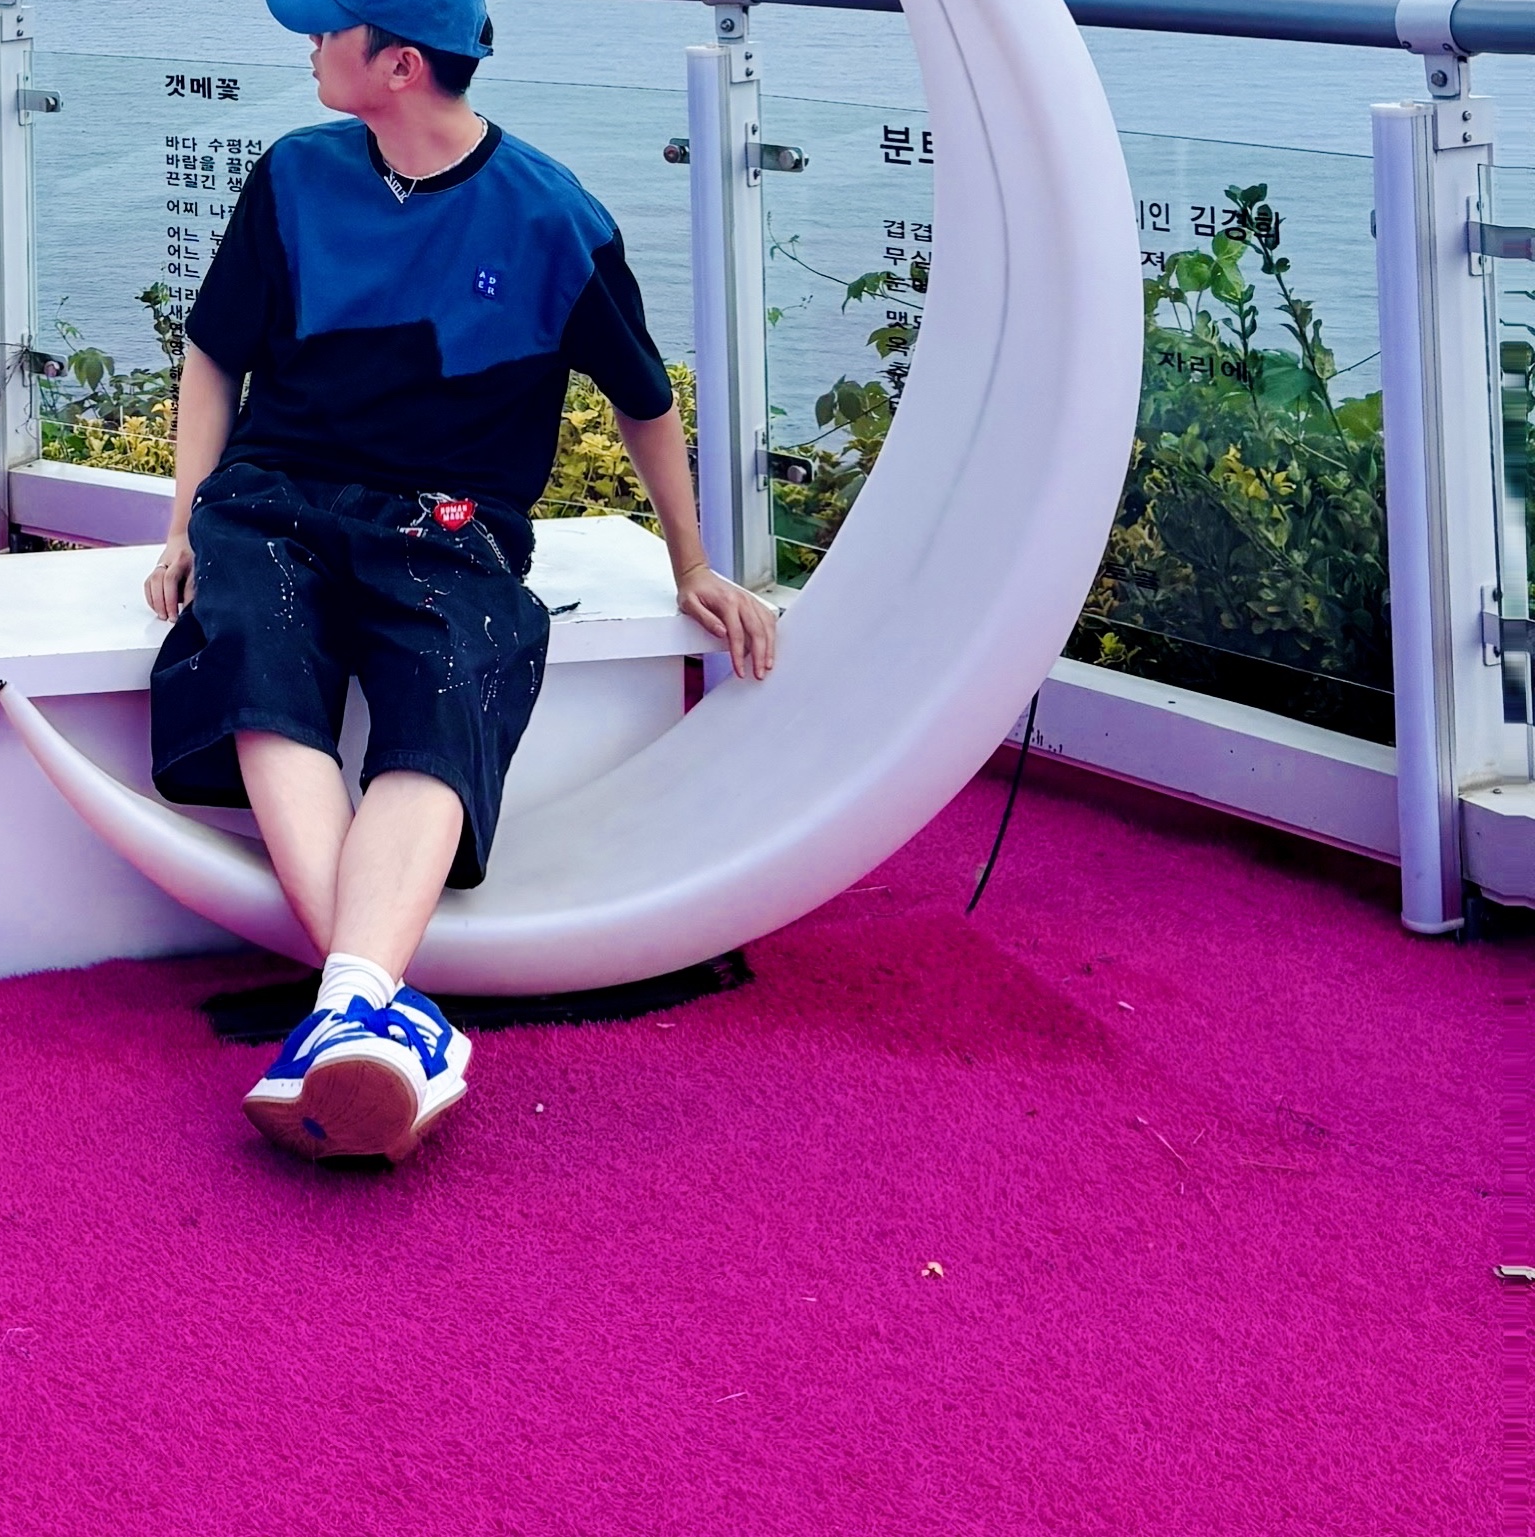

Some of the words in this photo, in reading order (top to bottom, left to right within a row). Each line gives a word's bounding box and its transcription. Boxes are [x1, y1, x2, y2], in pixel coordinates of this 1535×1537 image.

[164, 74, 240, 101] 갯메꽃
[166, 135, 197, 152] 바다
[208, 138, 262, 156] 수평선
[166, 154, 215, 172] 바람을
[166, 171, 216, 190] 끈질긴
[167, 200, 198, 217] 어찌
[167, 227, 200, 242] 어느
[167, 244, 200, 260] 어느
[168, 262, 201, 279] 어느
